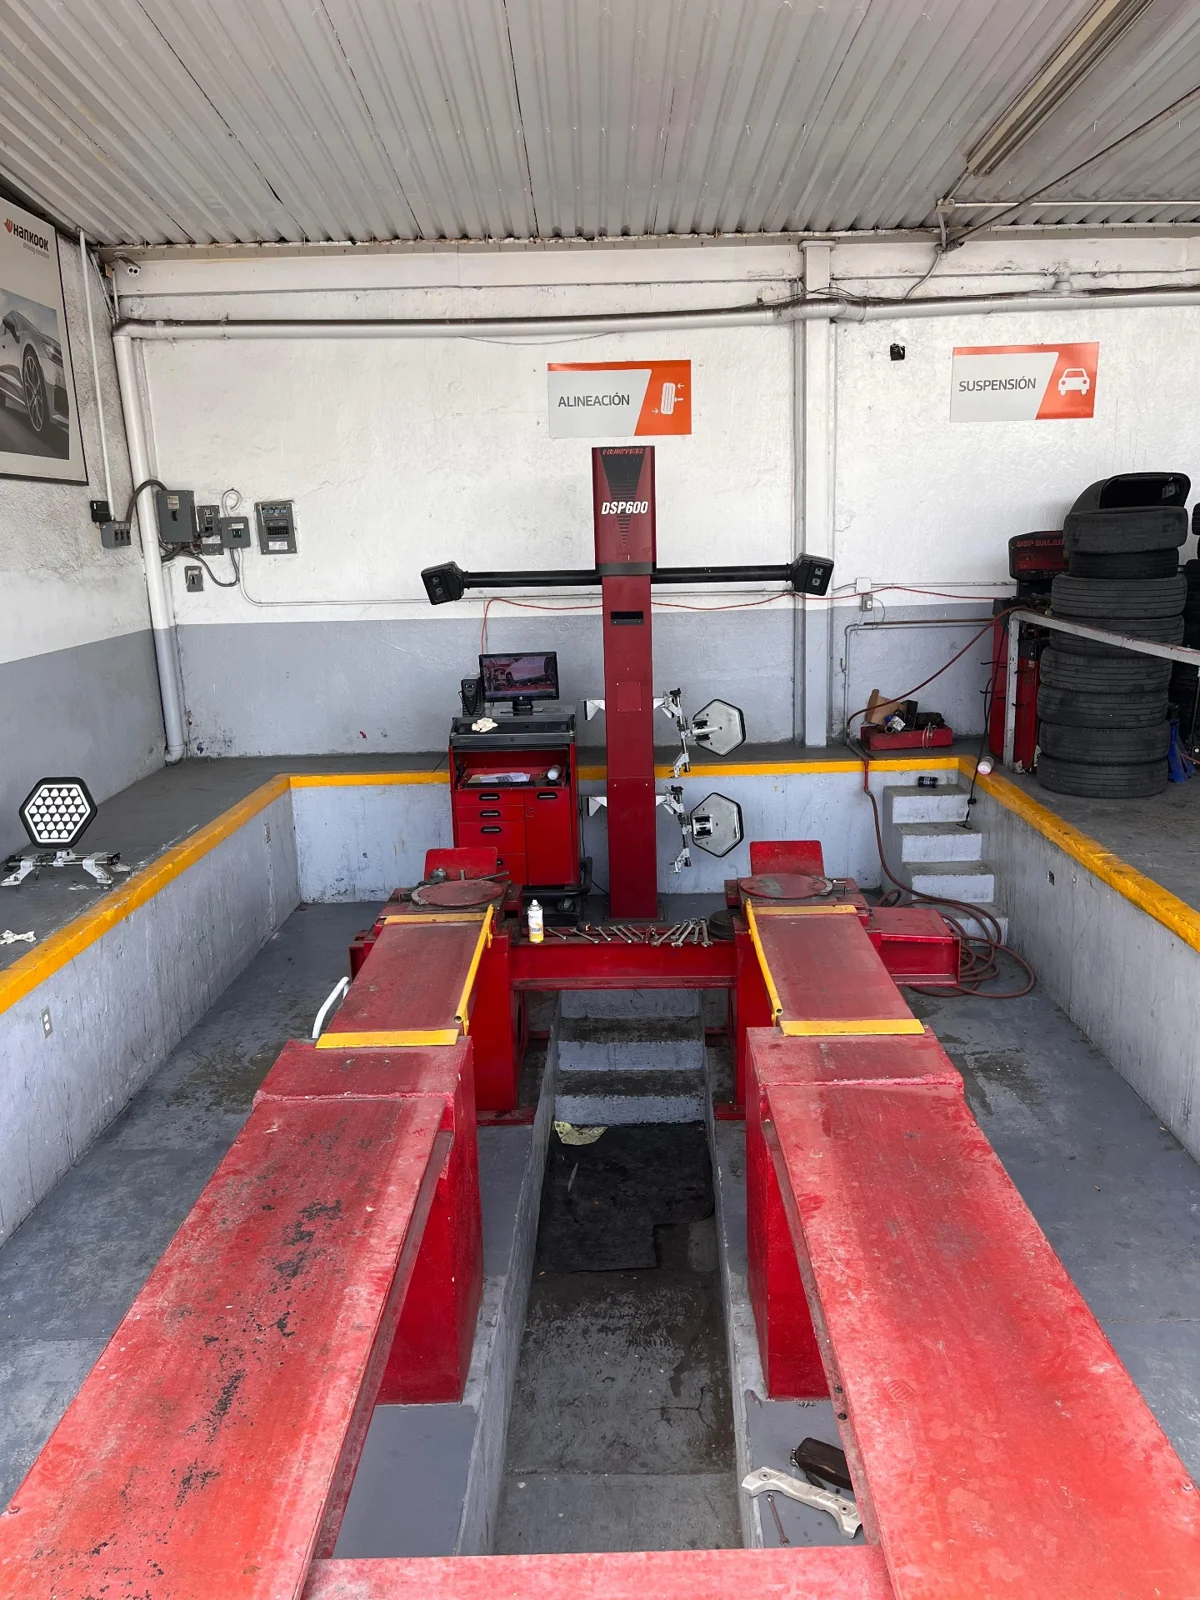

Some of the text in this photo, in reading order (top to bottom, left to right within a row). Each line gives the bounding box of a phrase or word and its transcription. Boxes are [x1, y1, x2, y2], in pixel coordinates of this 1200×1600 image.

[959, 376, 1037, 392] SUSPENSIÓN
[558, 392, 630, 408] ALINEACIÓN
[601, 501, 648, 515] DSP600
